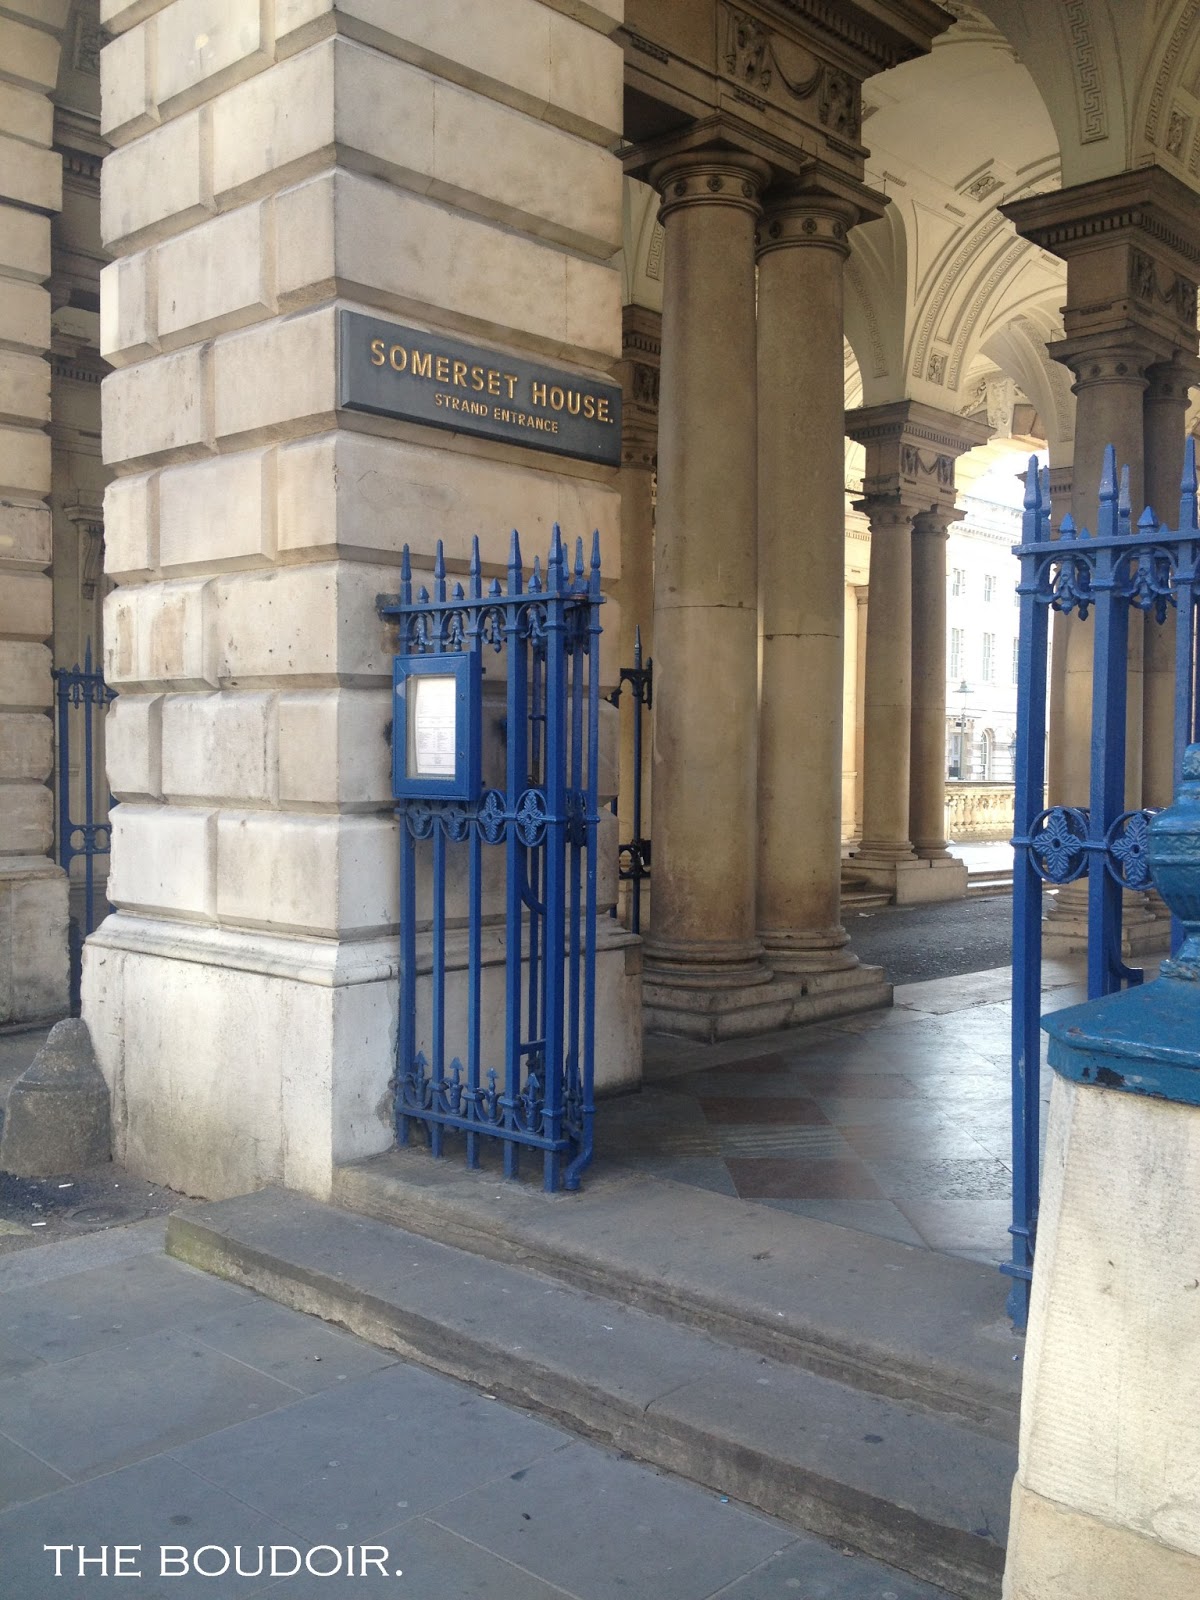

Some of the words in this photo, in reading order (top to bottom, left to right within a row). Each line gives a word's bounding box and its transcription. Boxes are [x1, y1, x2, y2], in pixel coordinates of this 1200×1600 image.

[370, 338, 518, 399] SOMERSET
[531, 381, 614, 424] HOUSE.
[434, 392, 488, 417] STRAND
[493, 408, 558, 434] ENTRANCE
